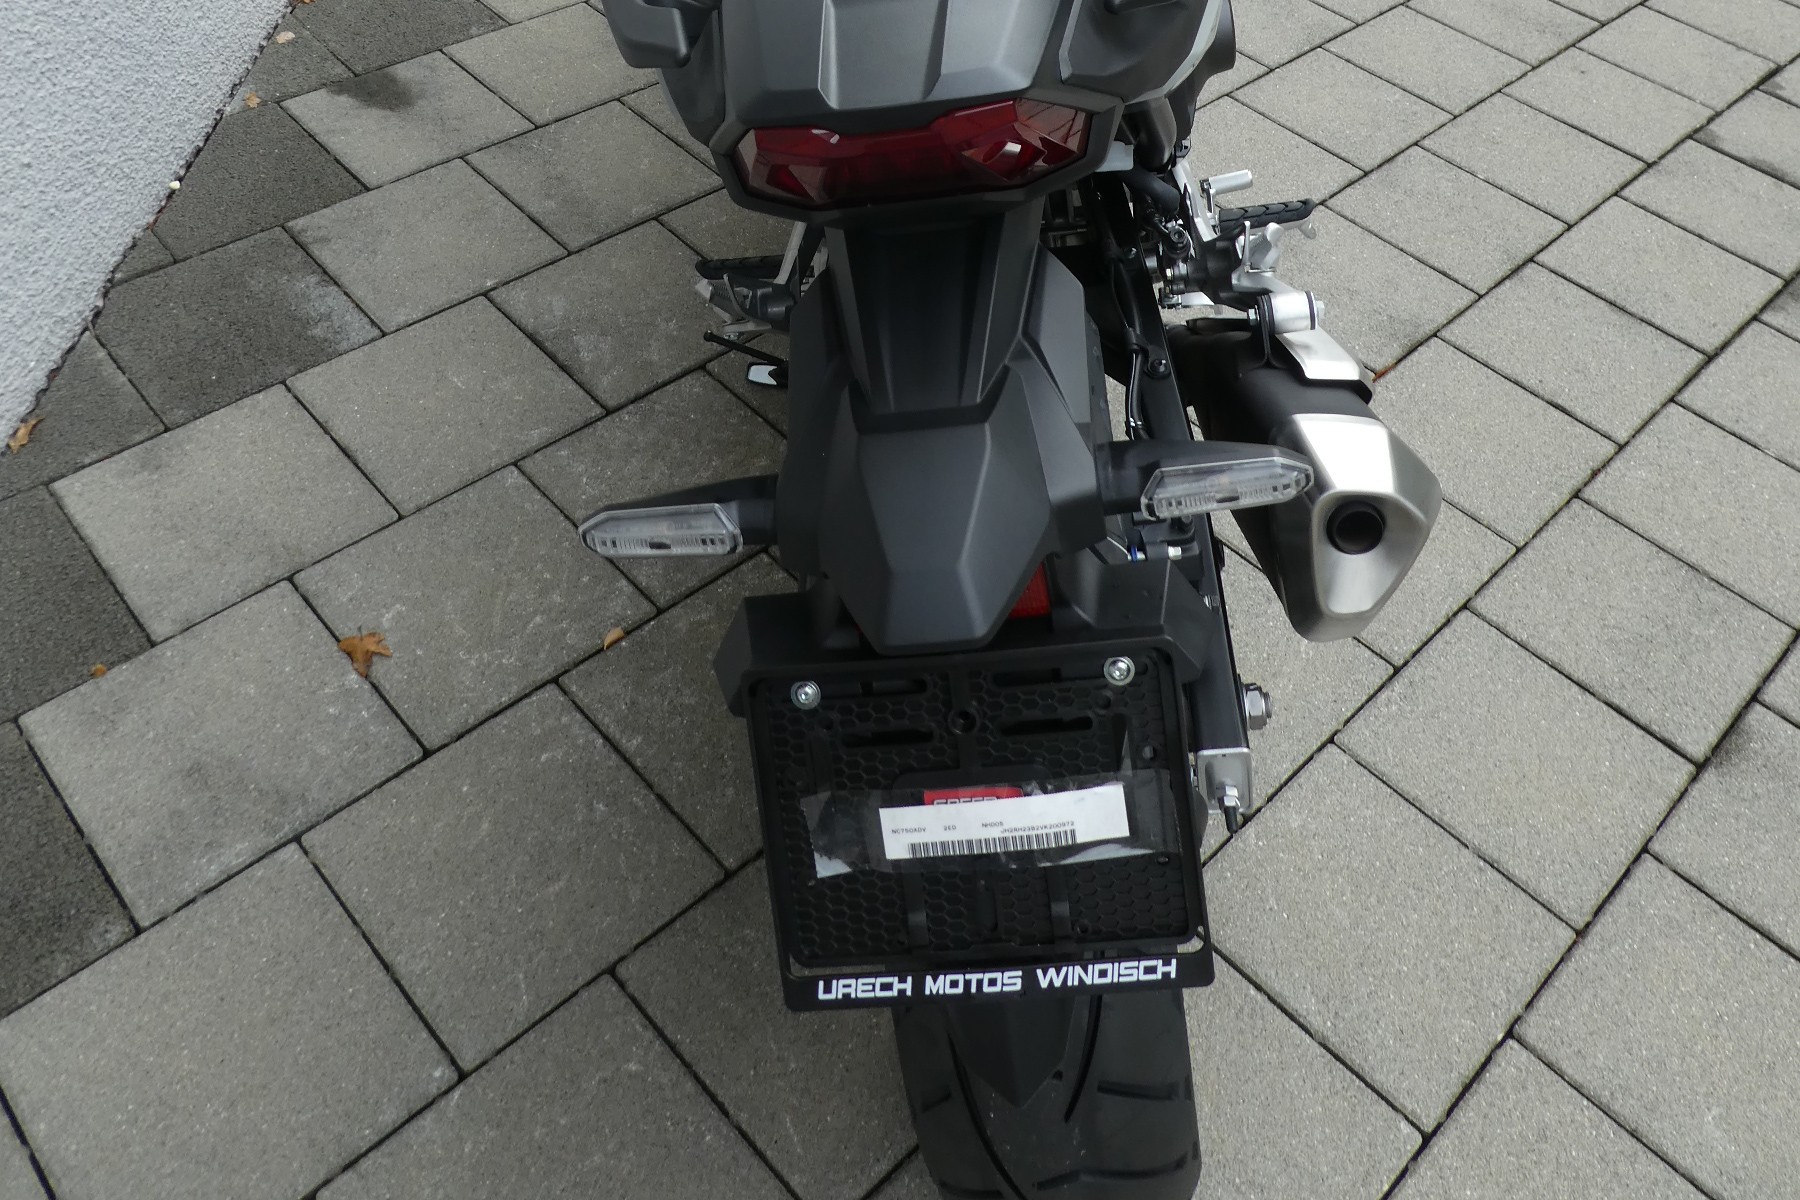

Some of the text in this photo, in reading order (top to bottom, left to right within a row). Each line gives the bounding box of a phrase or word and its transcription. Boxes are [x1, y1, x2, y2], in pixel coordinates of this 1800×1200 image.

[891, 826, 927, 835] NC750ADV
[817, 959, 1177, 1000] URECH MOTOS WINDISCH
